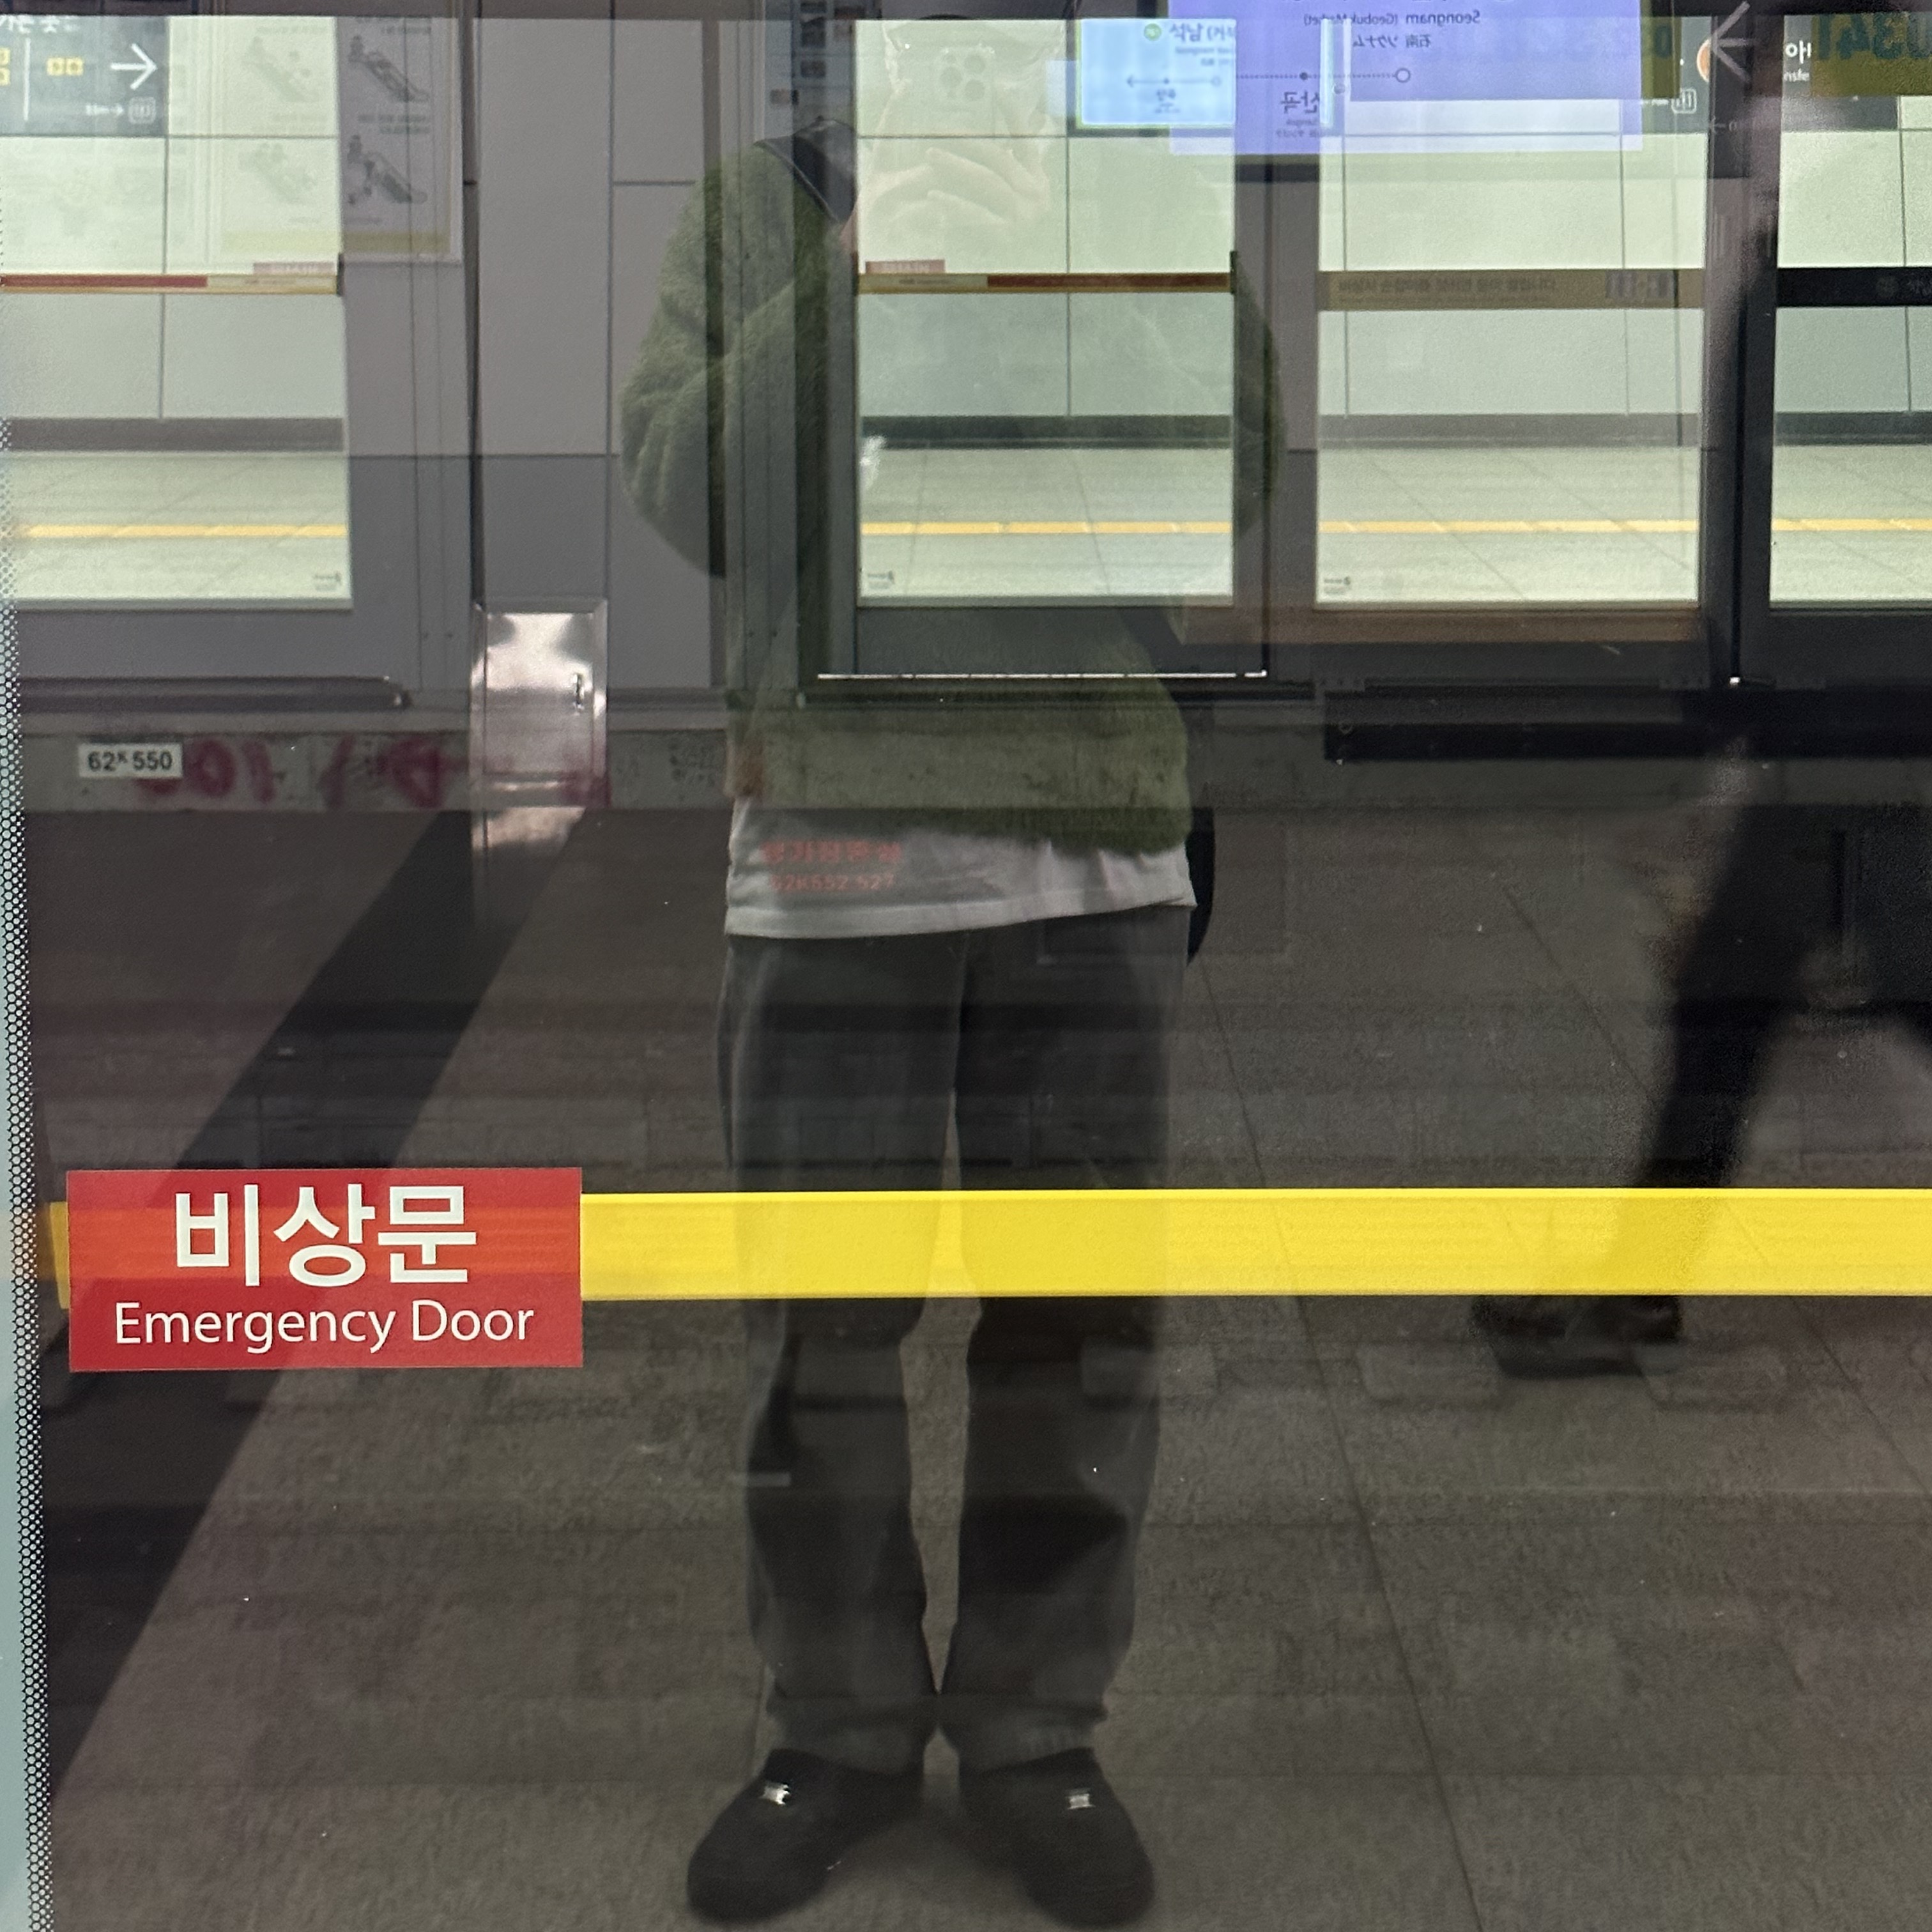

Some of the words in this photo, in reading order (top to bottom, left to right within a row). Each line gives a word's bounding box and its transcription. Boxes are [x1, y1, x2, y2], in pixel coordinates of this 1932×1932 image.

[174, 1182, 479, 1287] 비상문
[114, 1300, 397, 1354] Emergency
[411, 1298, 535, 1342] Door
